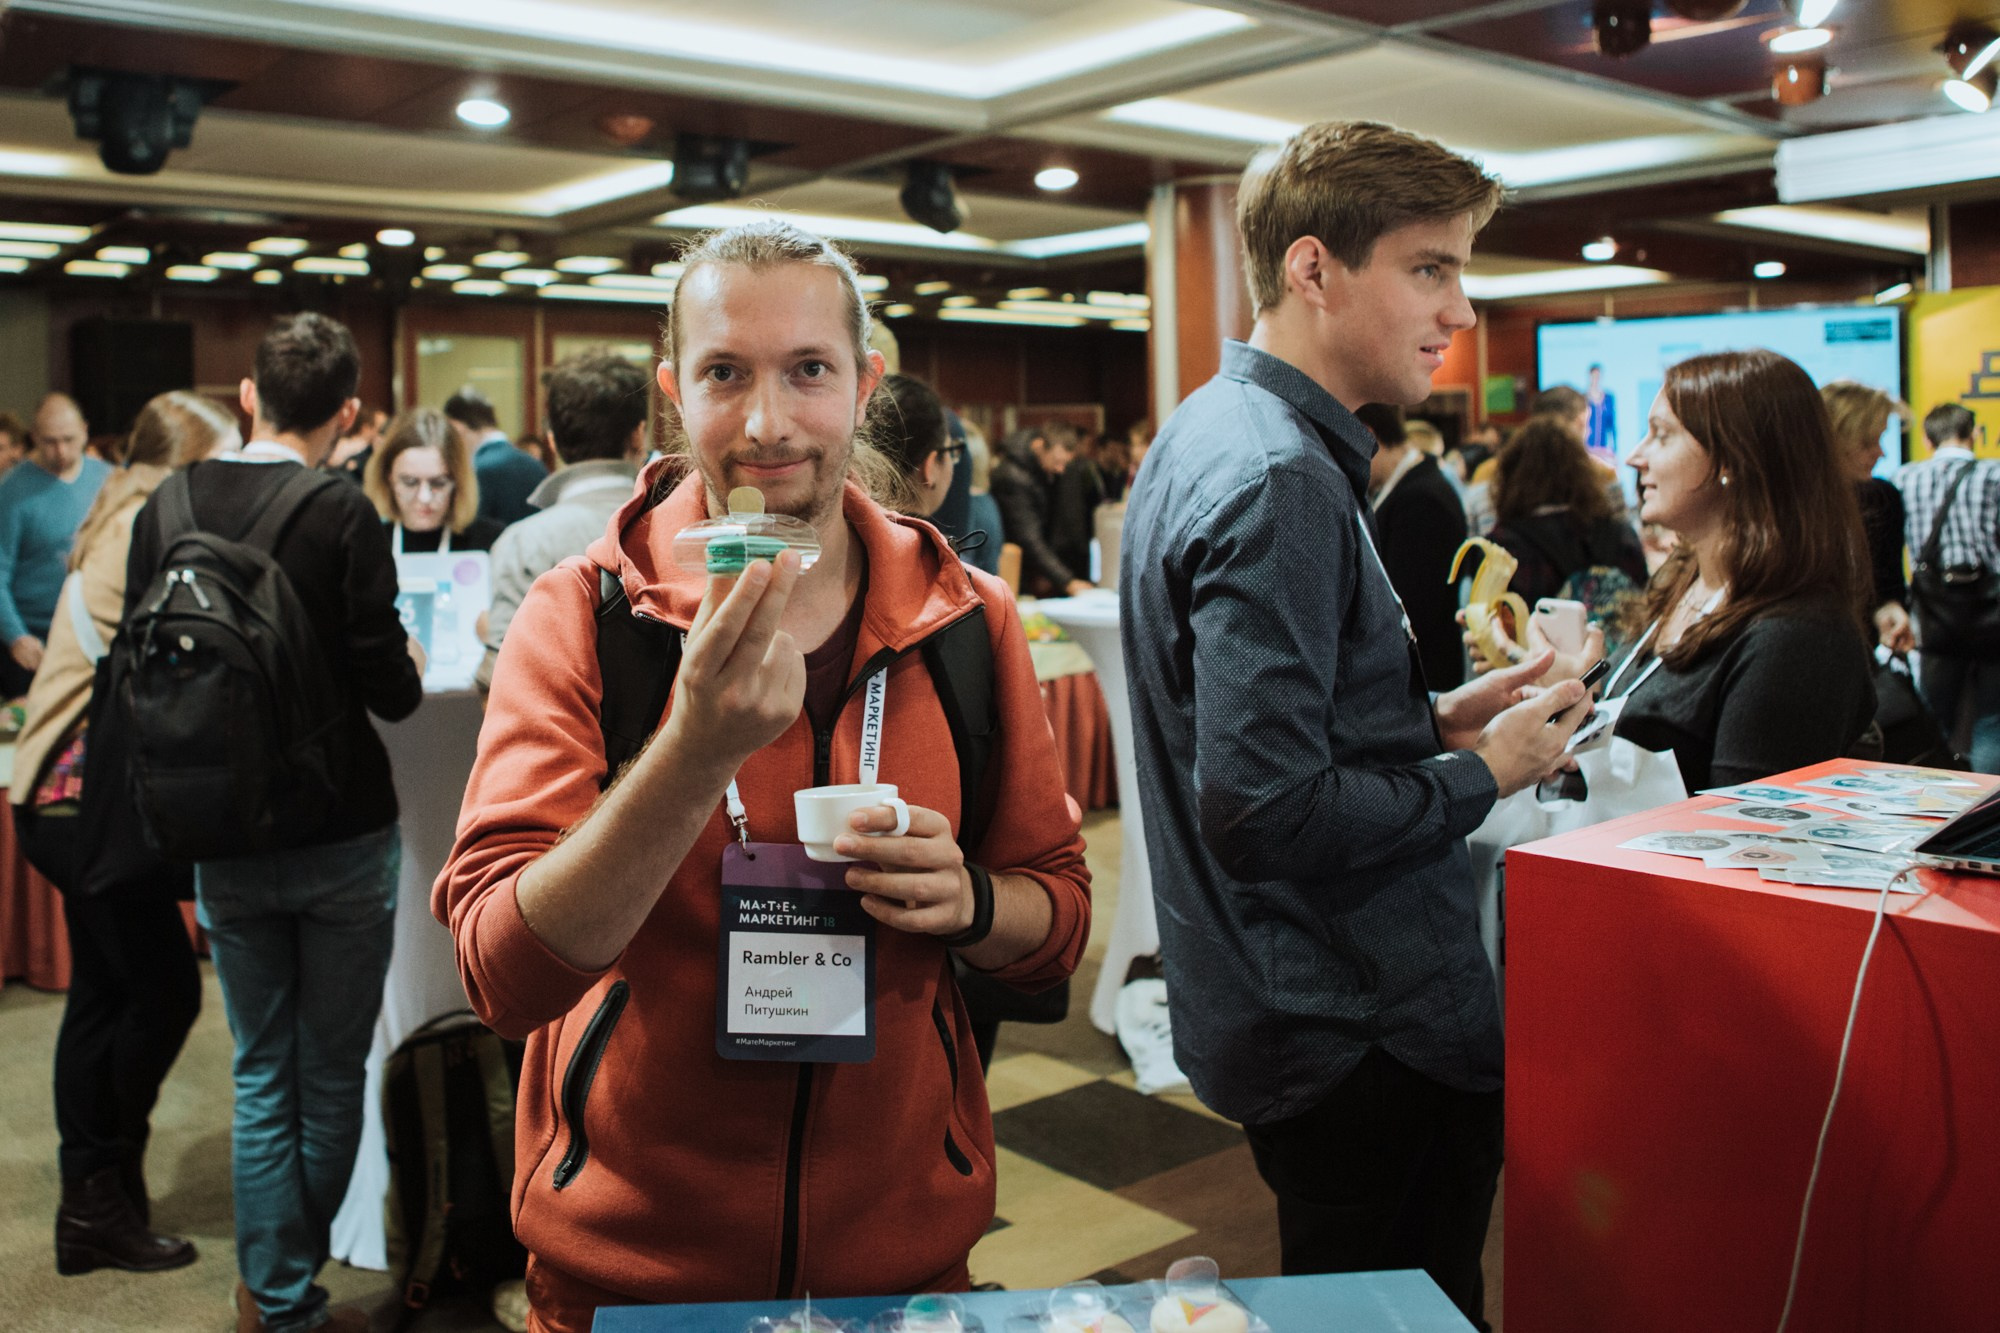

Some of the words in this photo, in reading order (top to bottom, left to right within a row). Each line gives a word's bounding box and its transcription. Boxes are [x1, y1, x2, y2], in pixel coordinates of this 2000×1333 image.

[863, 682, 882, 771] МАРКЕТИНГ
[738, 912, 820, 927] МАРКЕТИНГ
[822, 916, 836, 928] 18
[743, 950, 809, 966] Rambler
[814, 952, 826, 967] &
[831, 953, 852, 967] Co
[744, 986, 793, 1000] Андрей
[744, 1003, 809, 1019] Питушкин
[735, 1038, 797, 1048] #МатеМаркетинг
